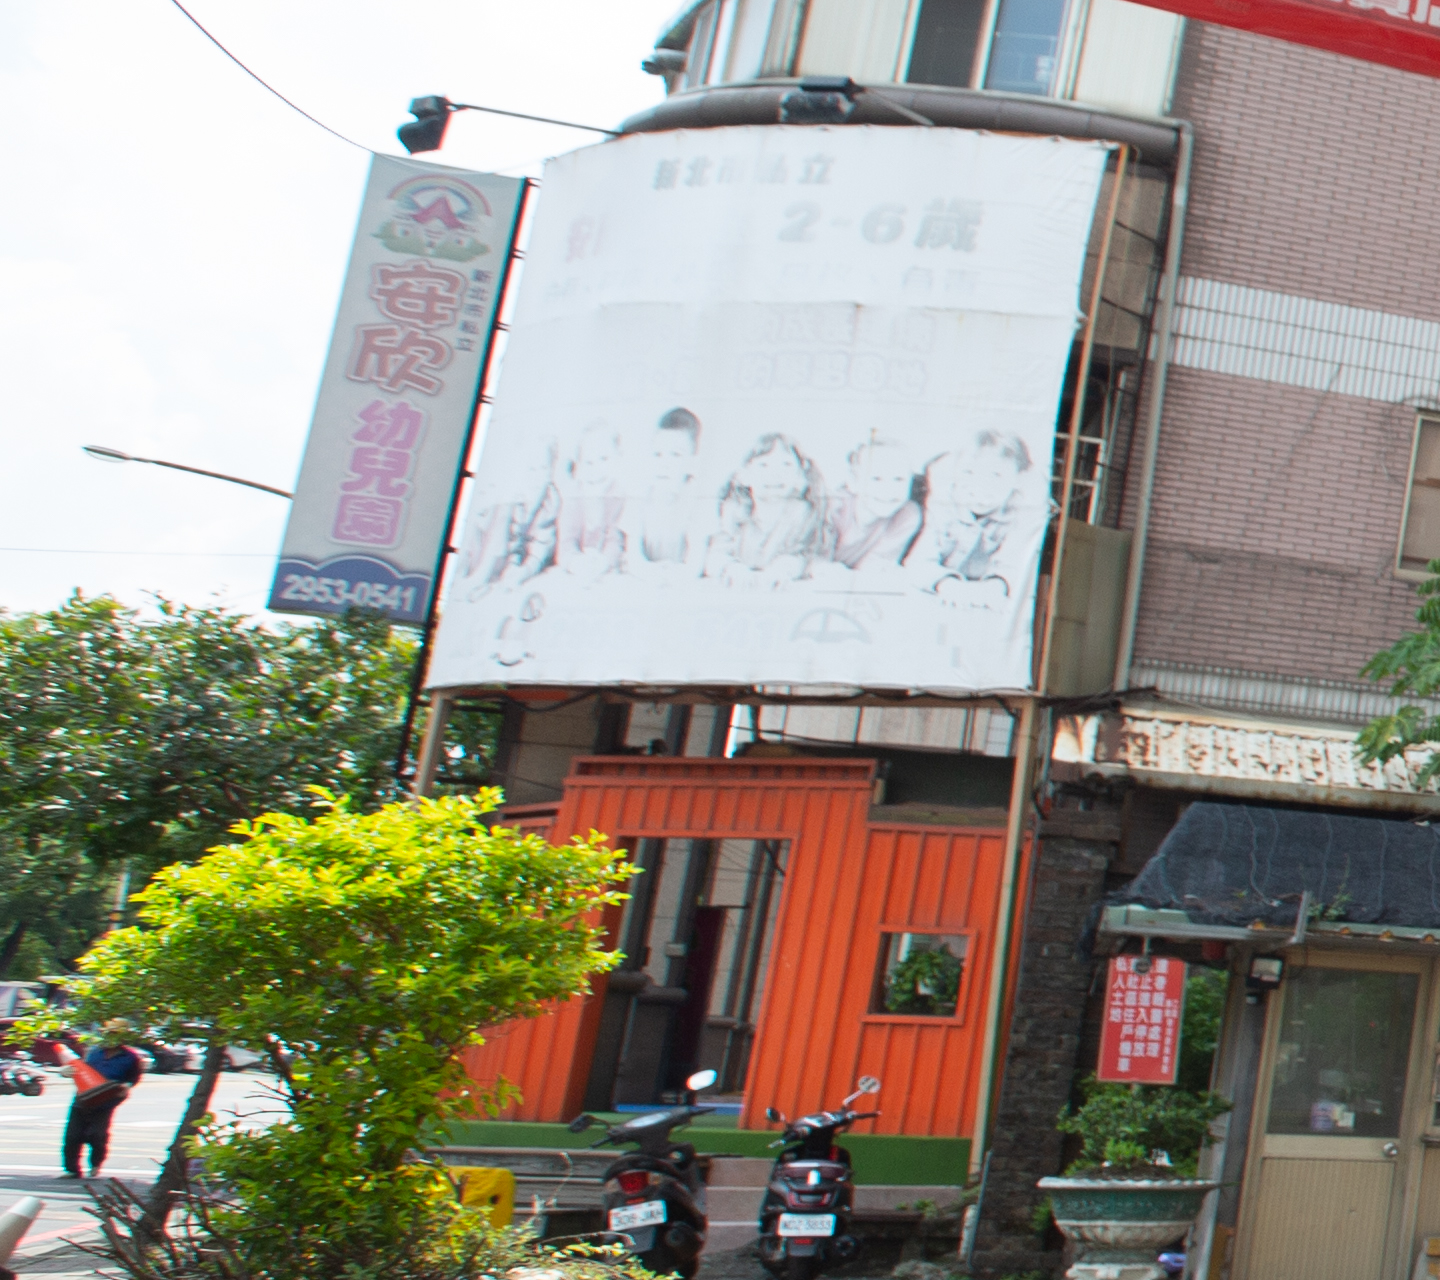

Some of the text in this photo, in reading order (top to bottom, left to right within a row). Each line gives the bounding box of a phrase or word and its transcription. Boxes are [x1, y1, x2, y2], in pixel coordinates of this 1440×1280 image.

[281, 572, 415, 612] 2953-0541
[1132, 962, 1155, 1058] 止進入停放
